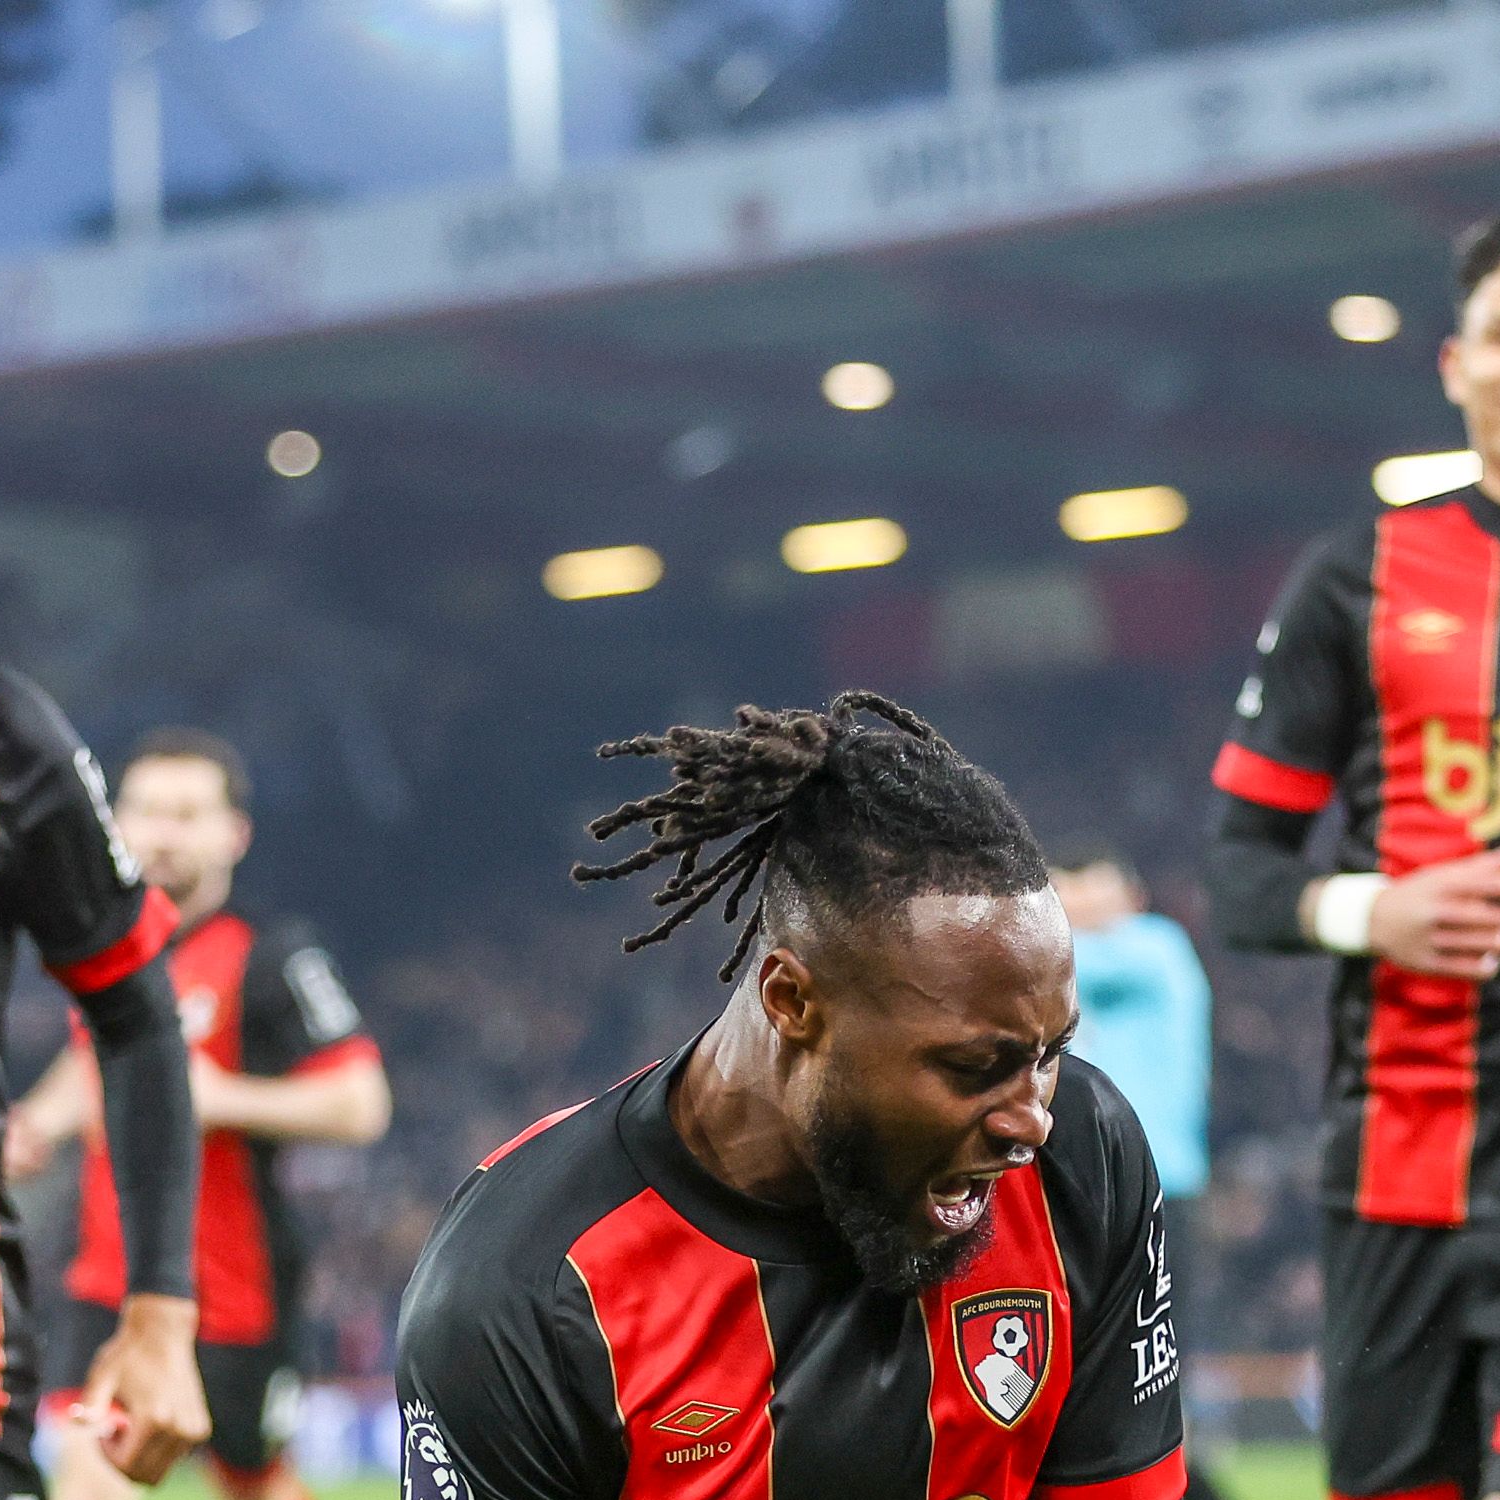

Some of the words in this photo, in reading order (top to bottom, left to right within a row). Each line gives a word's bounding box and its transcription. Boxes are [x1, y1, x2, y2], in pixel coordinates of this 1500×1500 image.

[962, 1305, 977, 1319] AFC
[978, 1298, 1042, 1312] BOURNEMOUTH
[665, 1441, 732, 1464] umbro
